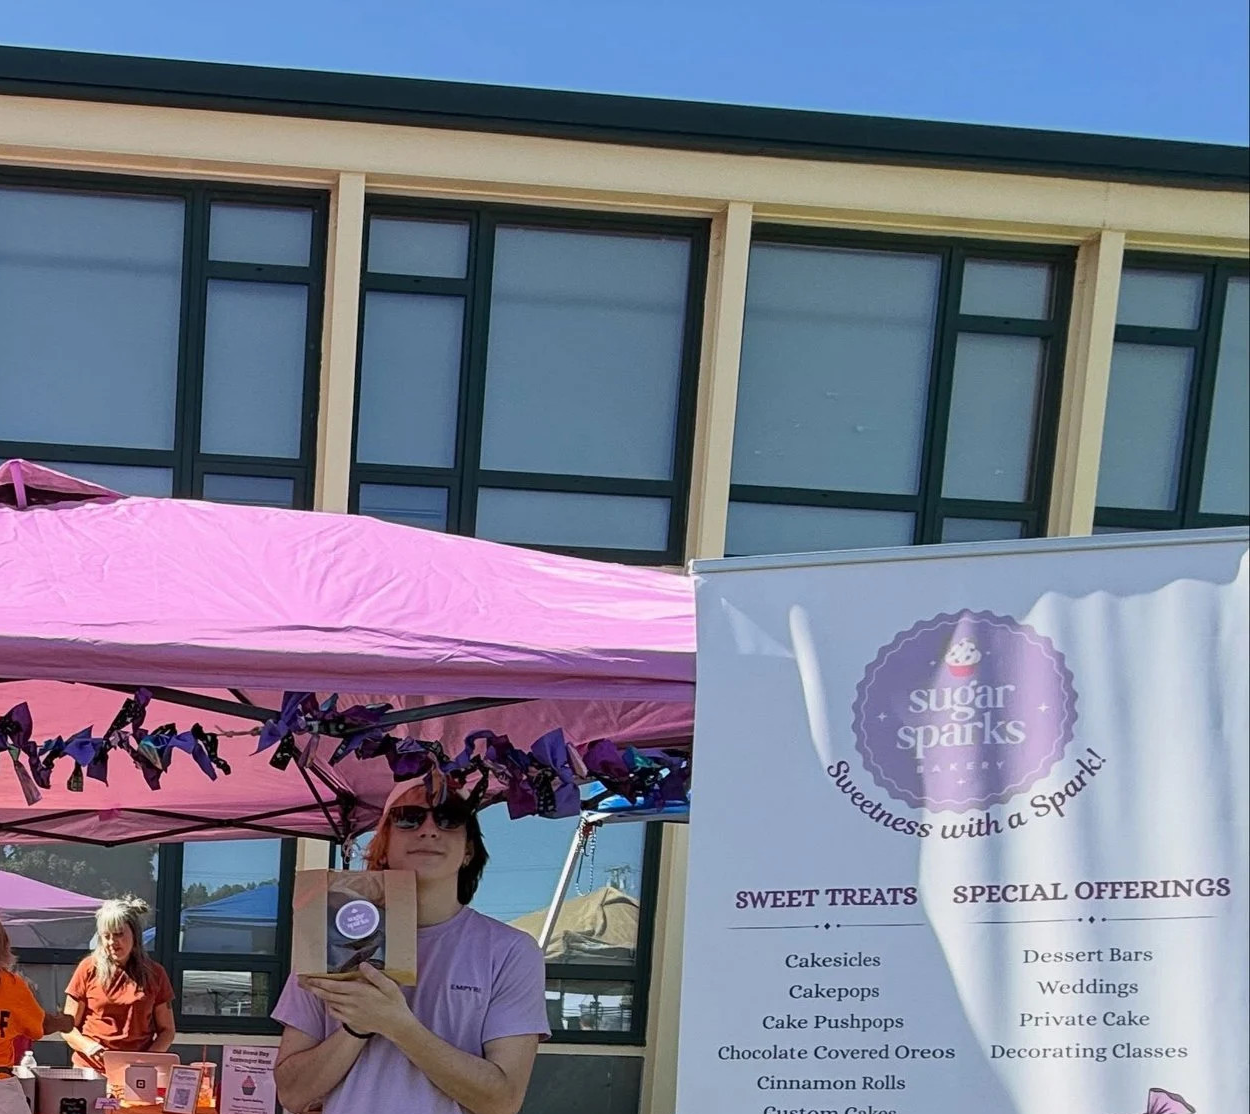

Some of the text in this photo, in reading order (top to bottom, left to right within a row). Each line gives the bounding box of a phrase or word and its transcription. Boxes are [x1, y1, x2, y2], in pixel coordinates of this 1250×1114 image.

[909, 680, 1016, 722] sugar
[895, 713, 1026, 759] sparks
[916, 761, 1005, 774] BAKERY
[827, 748, 1107, 839] Sweetness with a Spark!
[735, 887, 919, 909] SWEET TREATS
[952, 878, 1231, 905] SPECIAL OFFERINGS
[785, 953, 881, 968] Cakesicles
[1023, 947, 1153, 964] Dessert Bars
[789, 983, 880, 1002] Cakepops
[1037, 980, 1139, 998] Weddings
[762, 1014, 904, 1032] Cake Pushpops
[1019, 1011, 1150, 1028] Private Cake
[718, 1045, 956, 1061] Chocolate Covered Oreos
[990, 1043, 1188, 1062] Decorating Classes
[756, 1076, 906, 1091] Cinnamon Rolls
